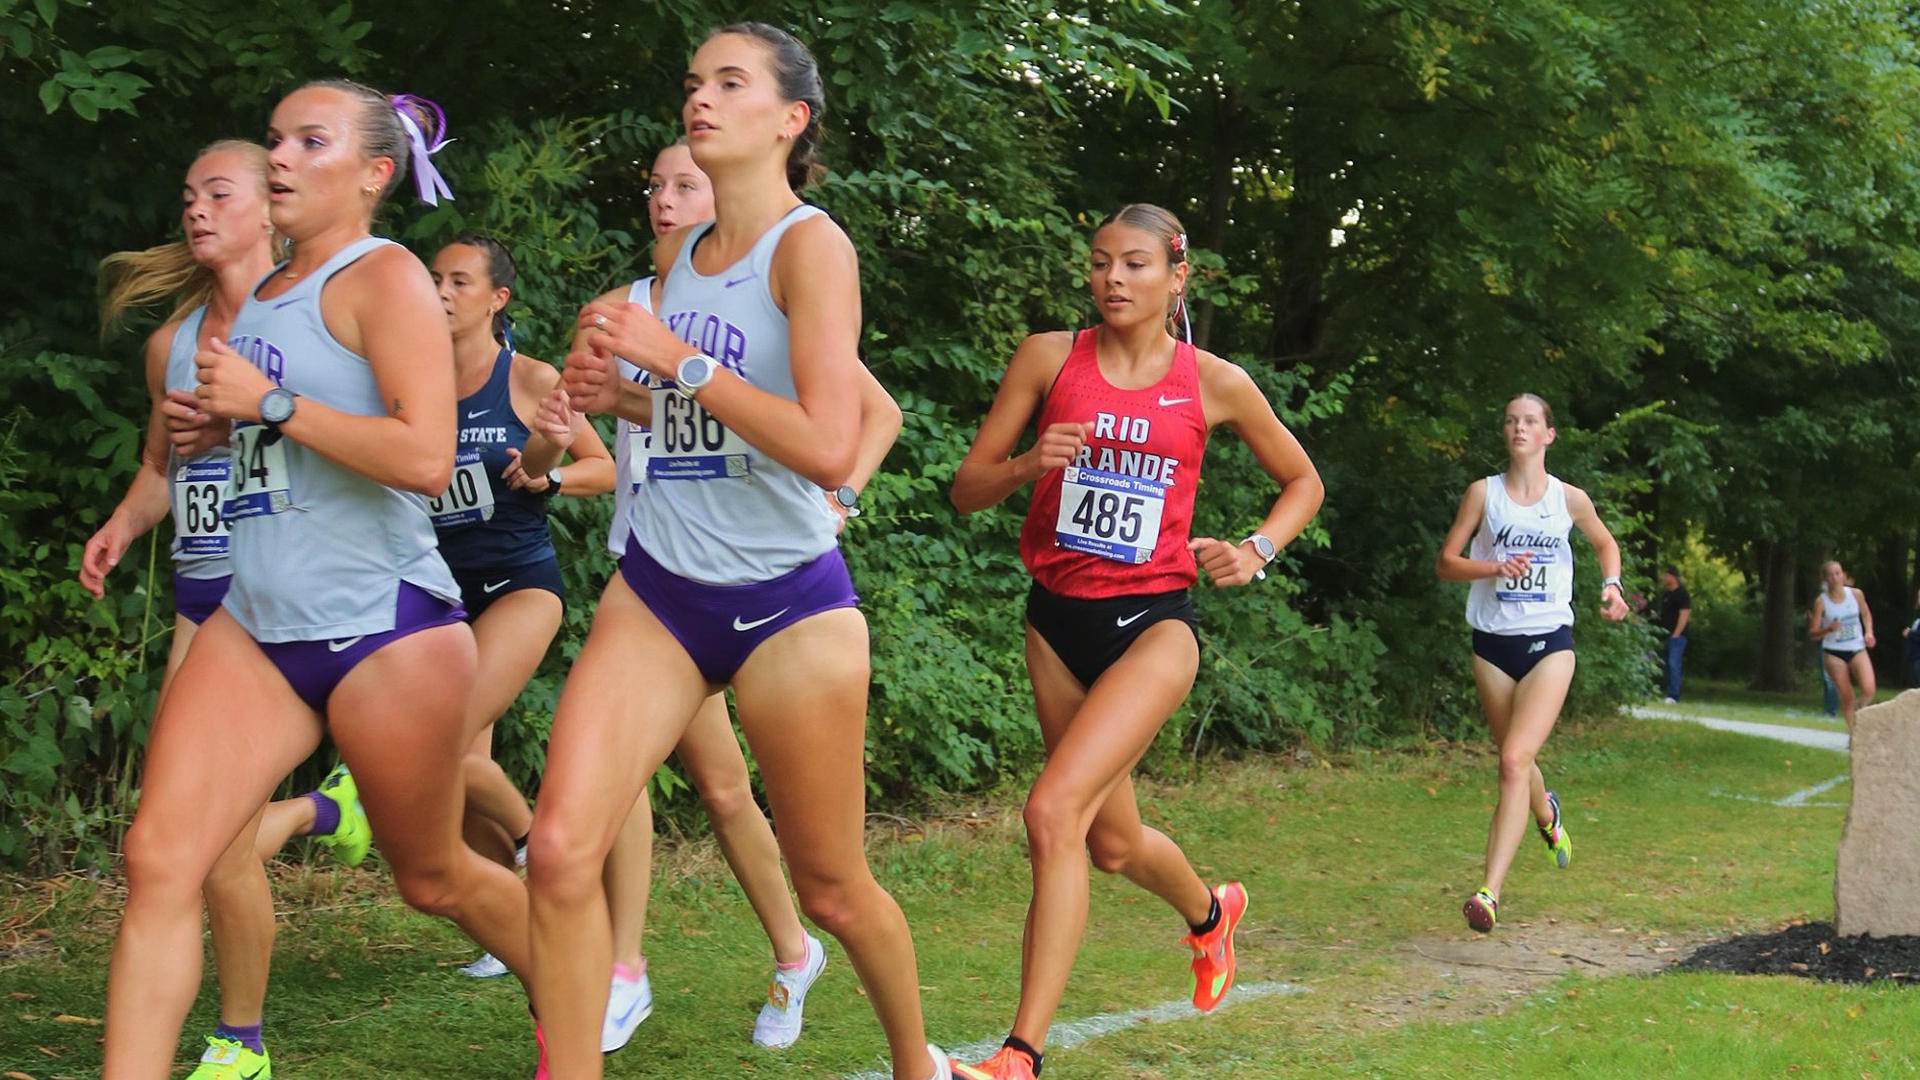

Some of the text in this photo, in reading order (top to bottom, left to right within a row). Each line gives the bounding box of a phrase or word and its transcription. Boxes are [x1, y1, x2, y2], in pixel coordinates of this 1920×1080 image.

[460, 427, 507, 443] STATE
[1094, 412, 1150, 444] RIO
[456, 451, 480, 462] Timing
[1074, 445, 1180, 486] RANDE
[1079, 471, 1165, 497] Crossroads Timing
[186, 484, 231, 533] 63
[1072, 489, 1145, 543] 485
[1493, 524, 1561, 549] Marian
[1528, 641, 1547, 653] NB
